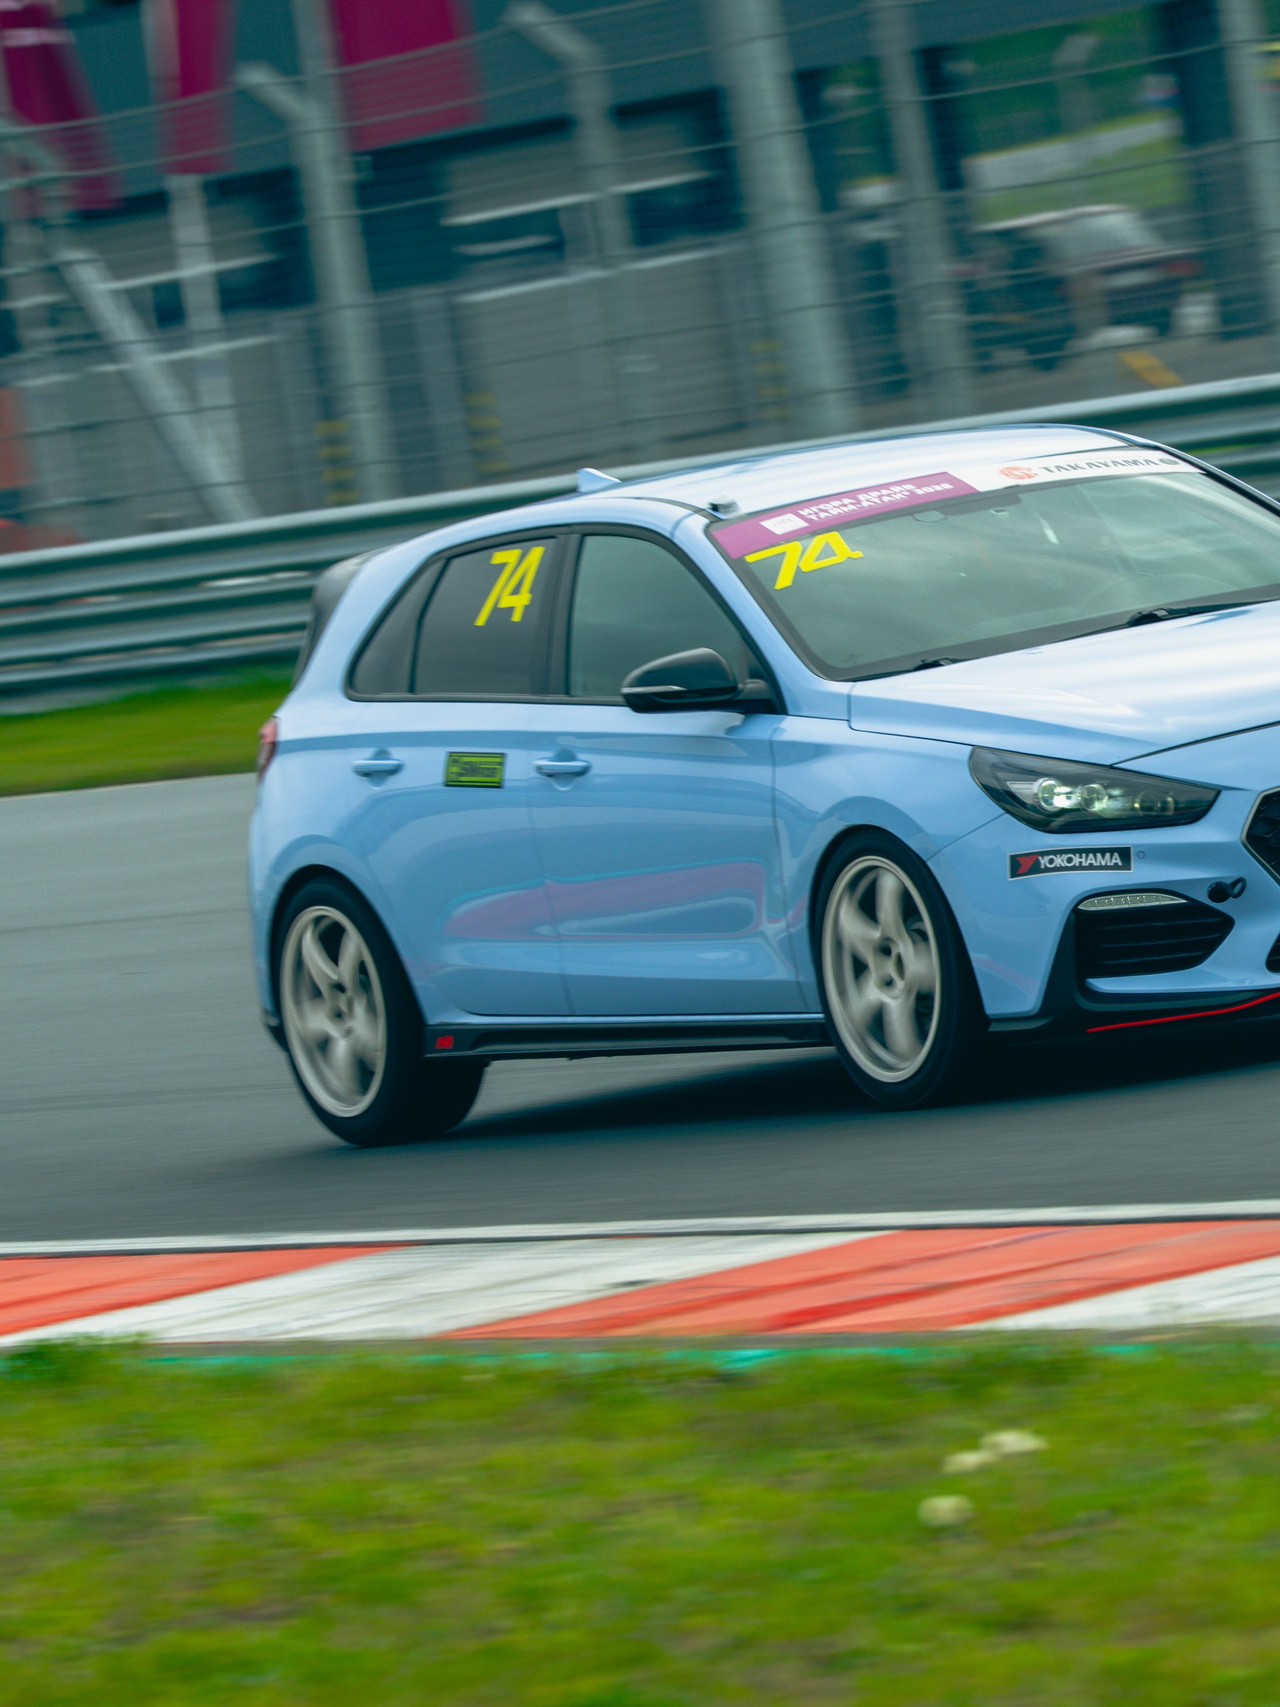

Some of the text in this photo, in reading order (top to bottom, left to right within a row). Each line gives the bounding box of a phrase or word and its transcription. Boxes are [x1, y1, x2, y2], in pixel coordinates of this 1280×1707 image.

[1041, 459, 1160, 473] TAKAYAMA
[798, 483, 917, 516] ИГОРА ДРАЙВ
[744, 530, 864, 591] 74
[474, 545, 546, 627] 74
[1038, 853, 1123, 868] YOKOHAMA
